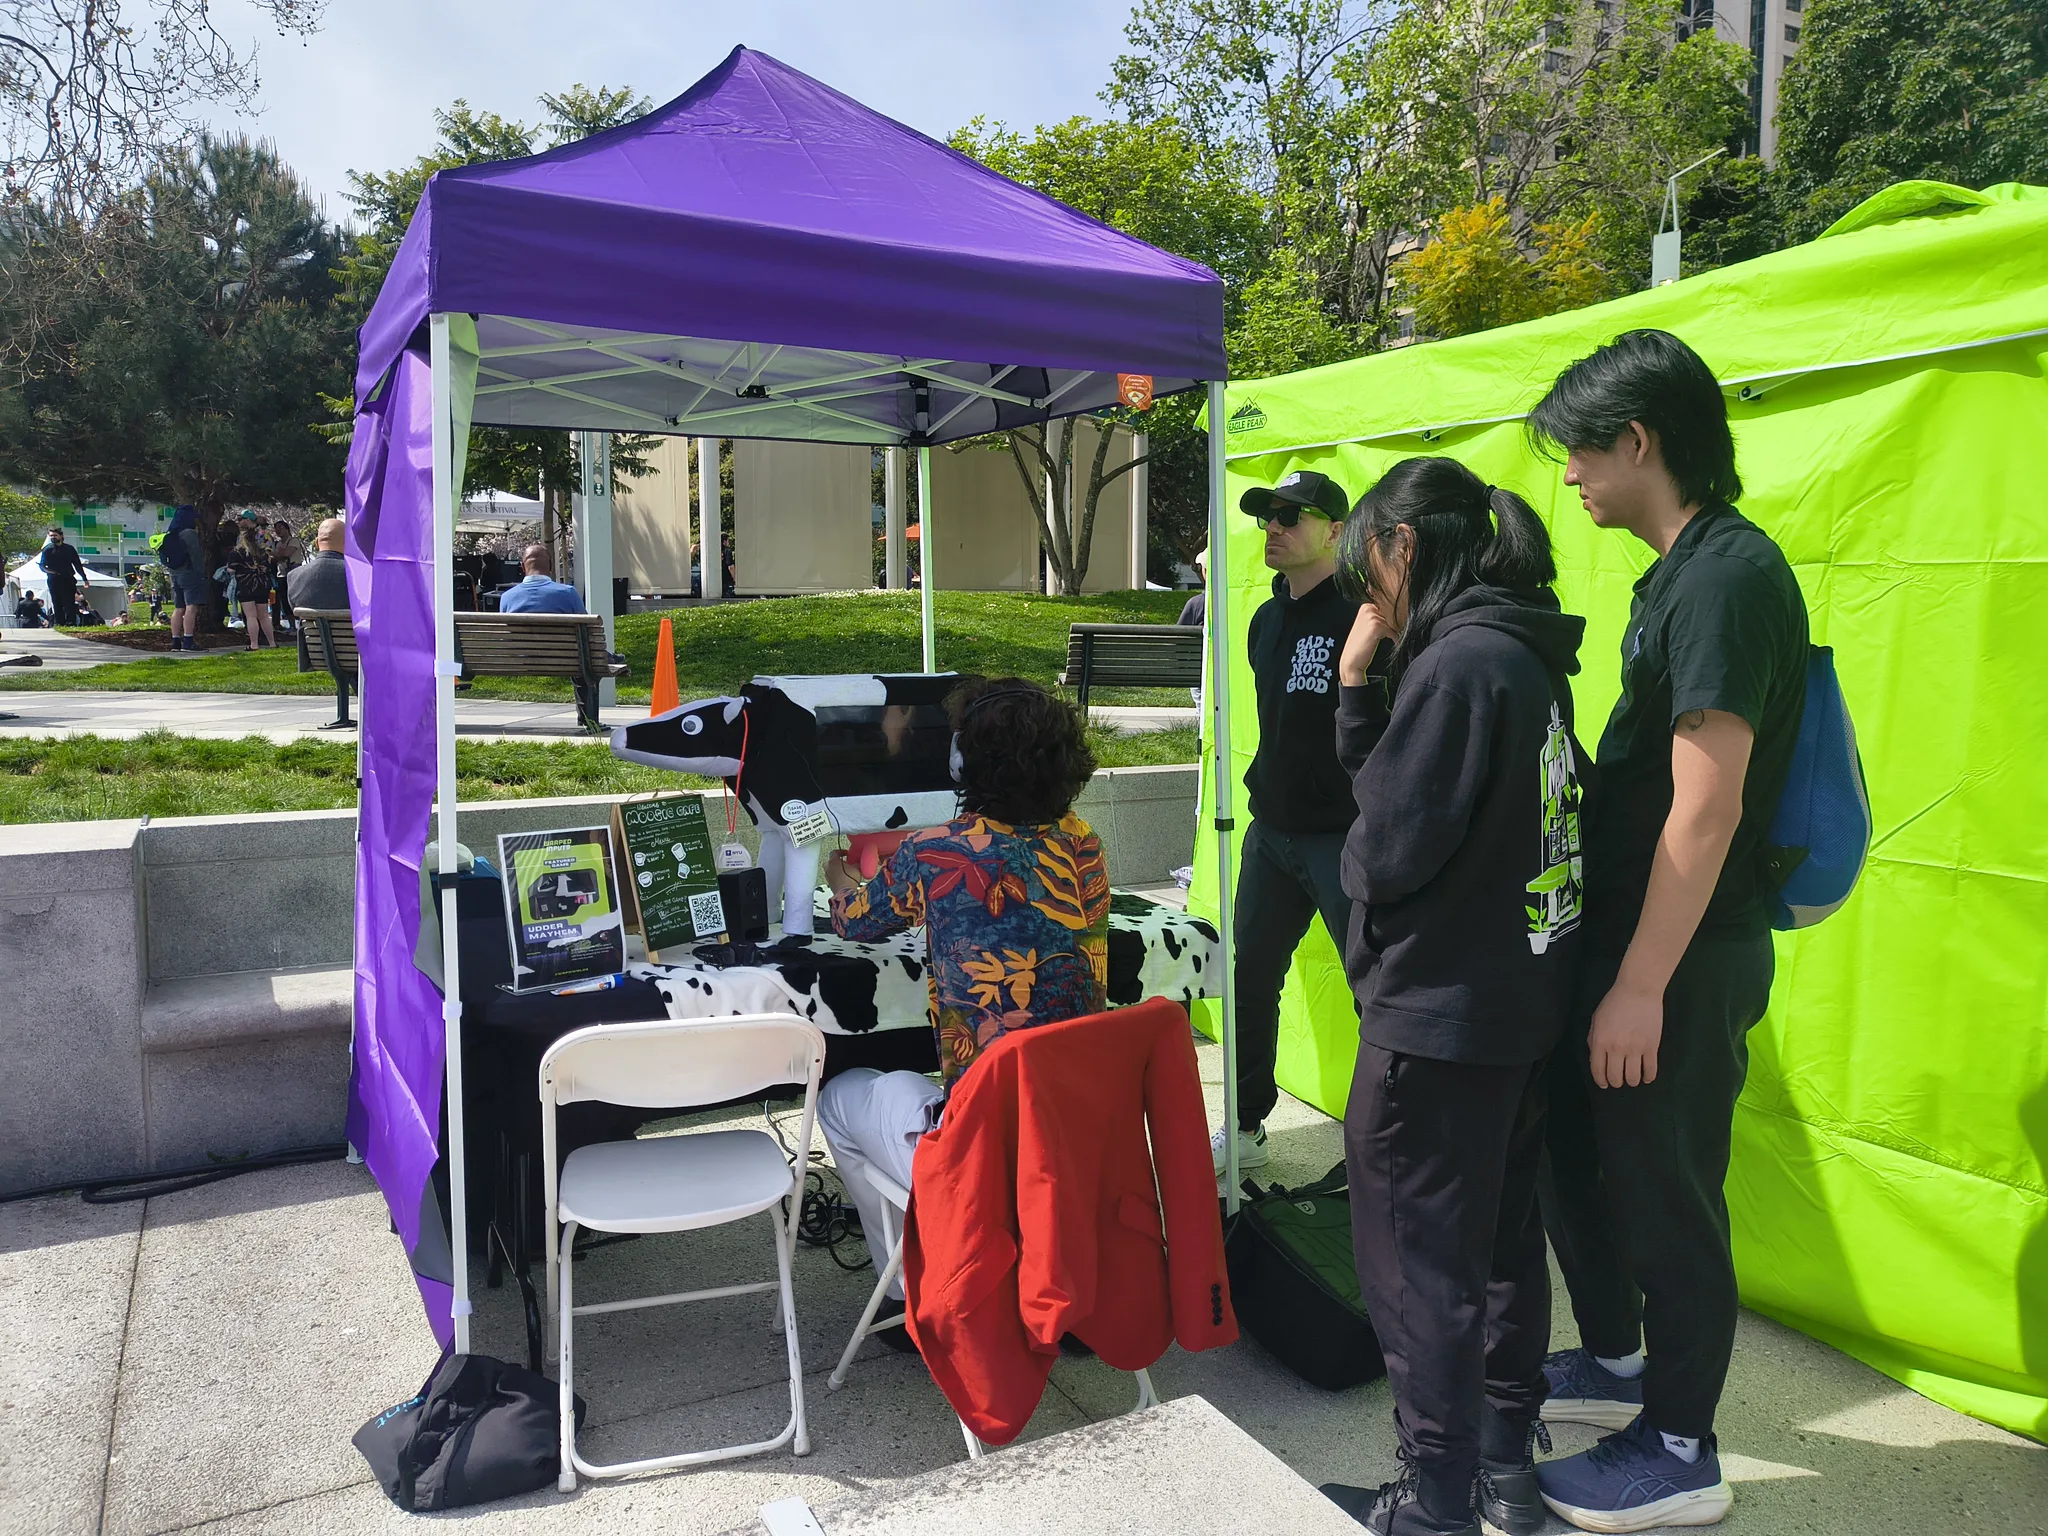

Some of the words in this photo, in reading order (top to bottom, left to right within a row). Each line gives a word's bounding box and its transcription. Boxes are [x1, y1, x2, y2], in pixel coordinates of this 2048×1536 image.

[1229, 421, 1245, 431] EAGLE
[1247, 417, 1263, 428] PEAK
[1296, 635, 1324, 653] BAD
[1297, 648, 1330, 663] BAD
[1291, 662, 1325, 677] NOT
[1287, 676, 1328, 693] GOOD
[626, 807, 674, 825] MOOSIC
[676, 804, 700, 816] CAFE
[528, 923, 563, 932] UDDER
[529, 928, 577, 939] MAYHEM
